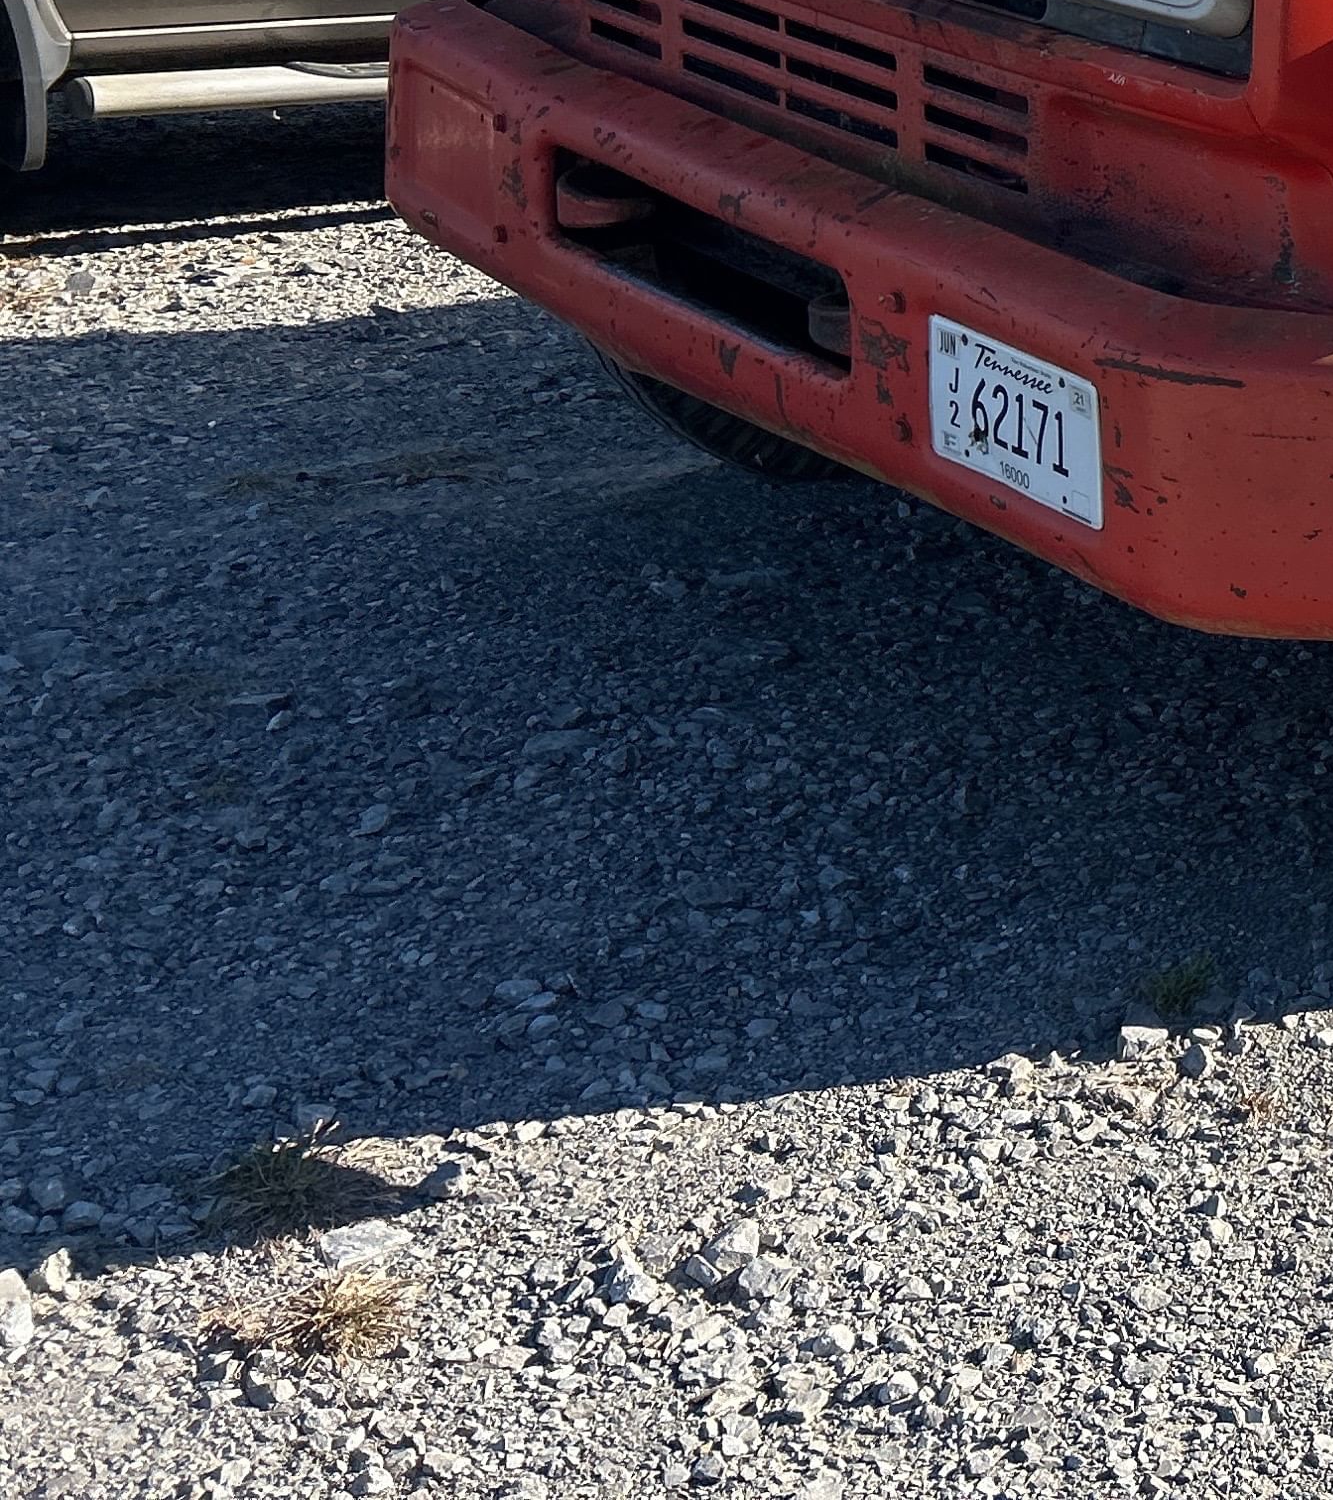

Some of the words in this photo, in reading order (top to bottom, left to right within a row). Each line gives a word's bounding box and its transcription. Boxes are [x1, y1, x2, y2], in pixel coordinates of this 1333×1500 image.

[939, 329, 956, 357] JUN
[974, 343, 1053, 395] Tennessee
[971, 378, 1069, 478] 62171
[999, 461, 1030, 490] 16000
